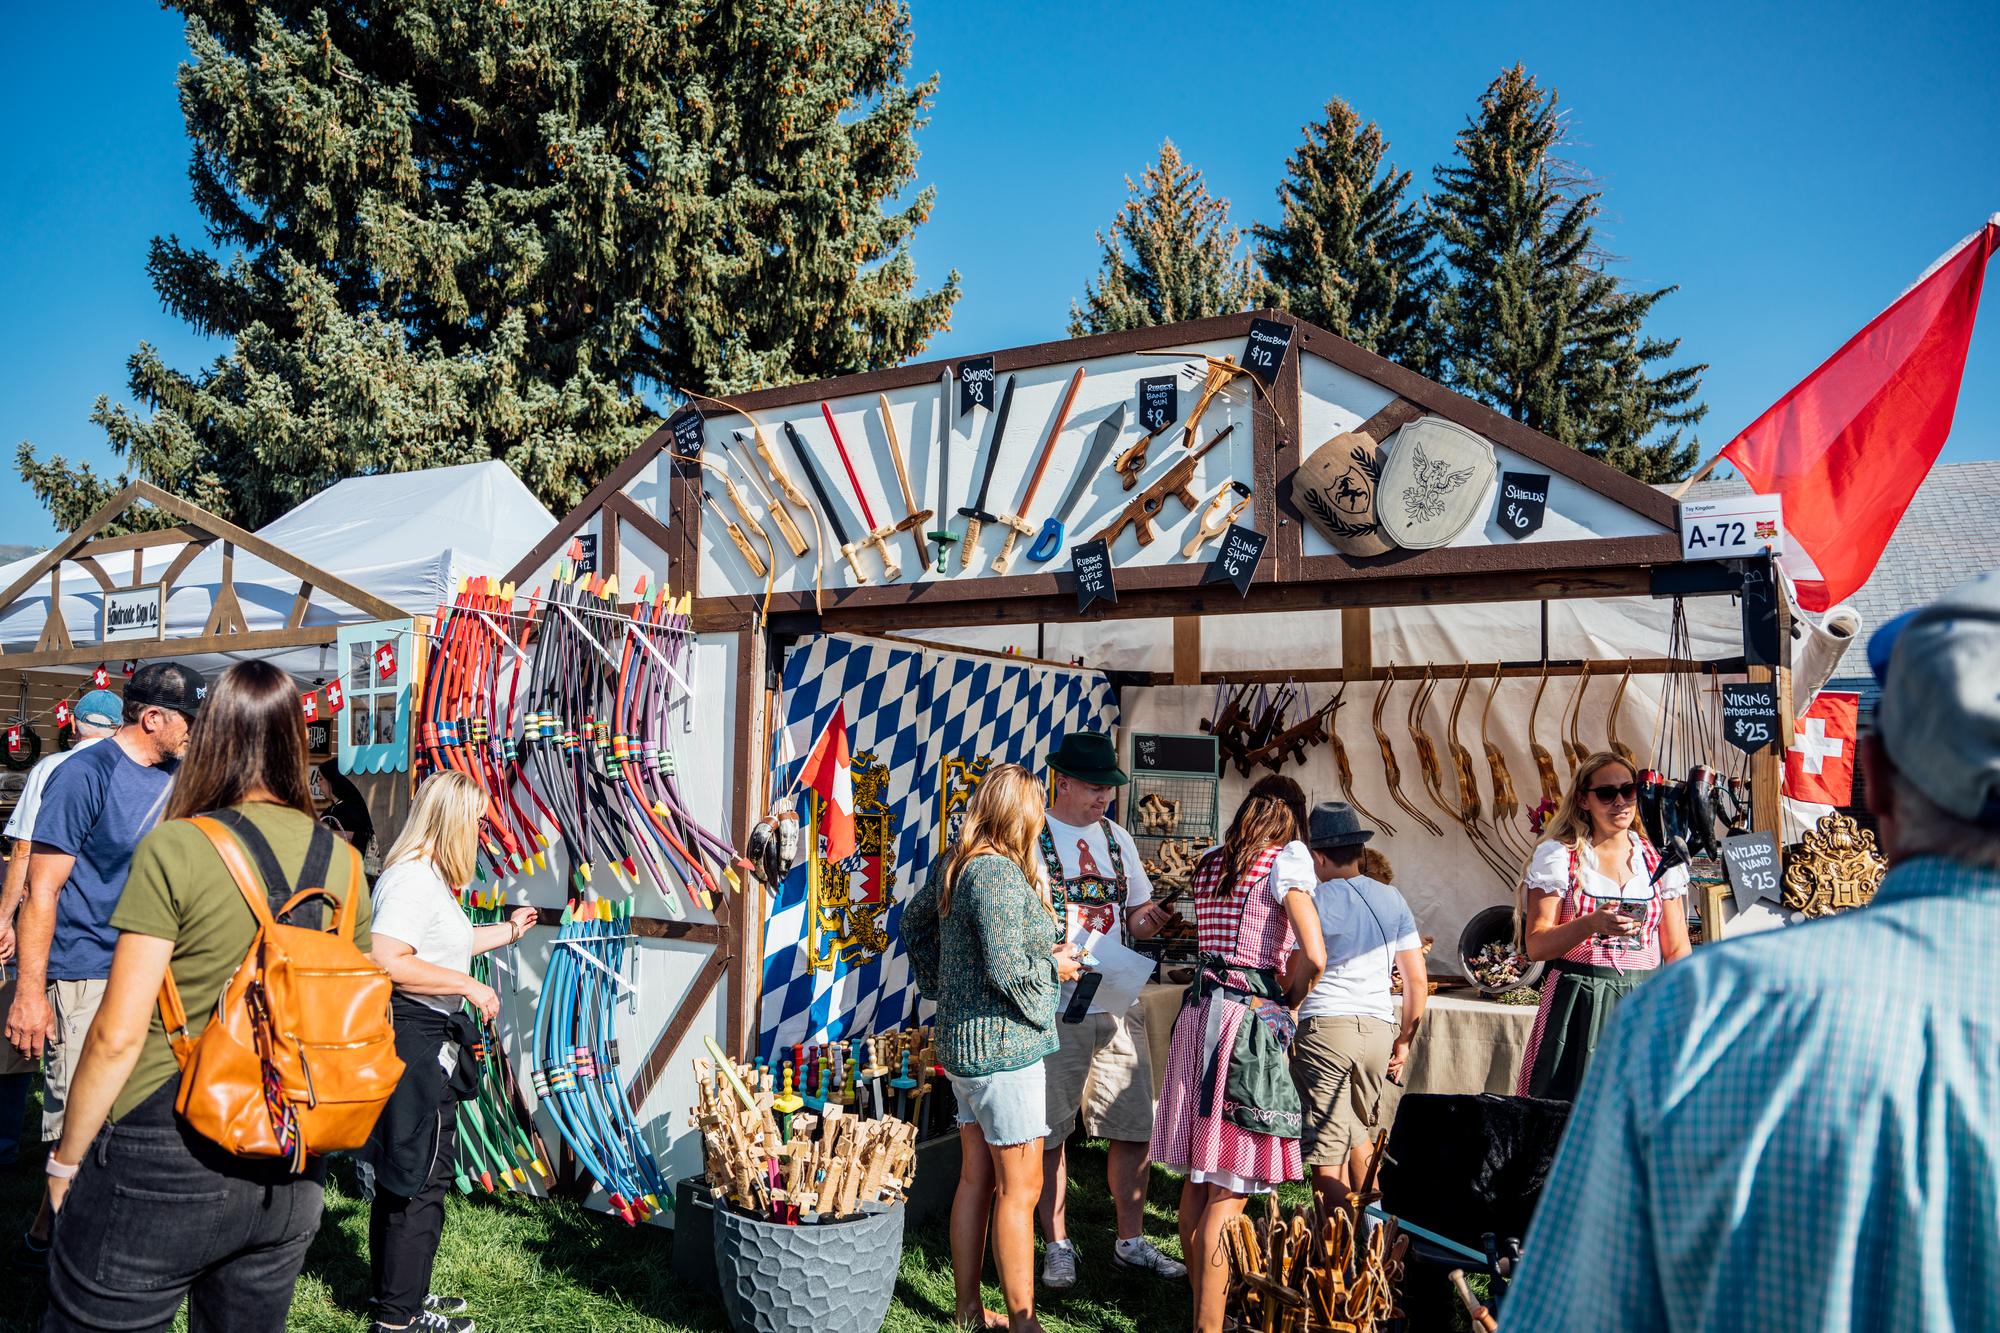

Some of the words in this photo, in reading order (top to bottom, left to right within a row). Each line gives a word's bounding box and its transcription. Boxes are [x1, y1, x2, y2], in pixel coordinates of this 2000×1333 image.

[1251, 345, 1272, 366] $12
[962, 368, 994, 382] SWORDS
[969, 382, 984, 402] $8
[1146, 392, 1168, 400] BAND
[1152, 398, 1168, 406] GUN
[1147, 408, 1164, 428] $8
[688, 441, 700, 451] $15
[1505, 485, 1545, 503] SHIELDS
[1507, 503, 1529, 528] $6
[1688, 522, 1746, 549] A-72
[1230, 536, 1258, 555] SLING
[1076, 554, 1103, 567] RUBBER
[1227, 548, 1253, 563] SHOT
[579, 560, 592, 570] $12
[1083, 563, 1102, 573] BAND
[1224, 557, 1239, 576] $6
[1080, 571, 1103, 583] RIFLE
[1086, 581, 1105, 592] $12
[1724, 693, 1770, 706] VIKING
[1723, 707, 1776, 716] HYDROFLASK
[1734, 719, 1769, 741] $25
[1143, 755, 1155, 765] $6
[1727, 844, 1772, 861] WIZARD
[1738, 856, 1772, 871] WAND
[1741, 871, 1776, 890] $25
